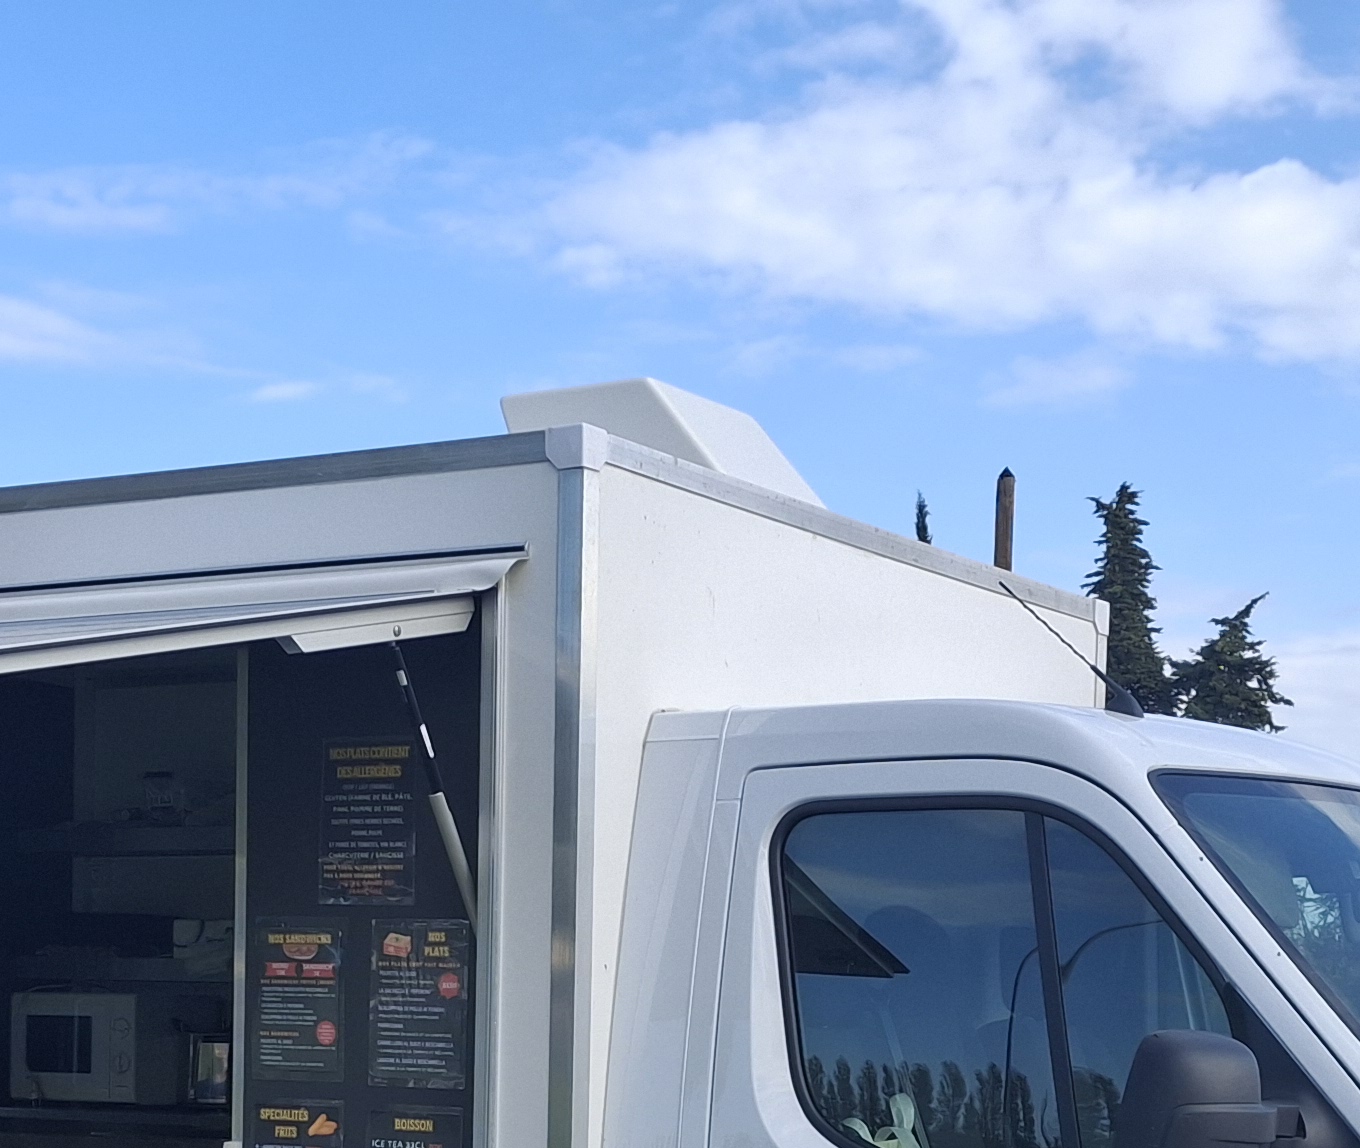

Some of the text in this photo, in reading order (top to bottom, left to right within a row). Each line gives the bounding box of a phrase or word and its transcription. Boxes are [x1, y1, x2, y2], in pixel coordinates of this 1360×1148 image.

[424, 946, 449, 957] PLATS
[394, 1117, 433, 1132] BOISSON
[371, 1139, 385, 1148] ICE
[387, 1140, 403, 1148] TEA
